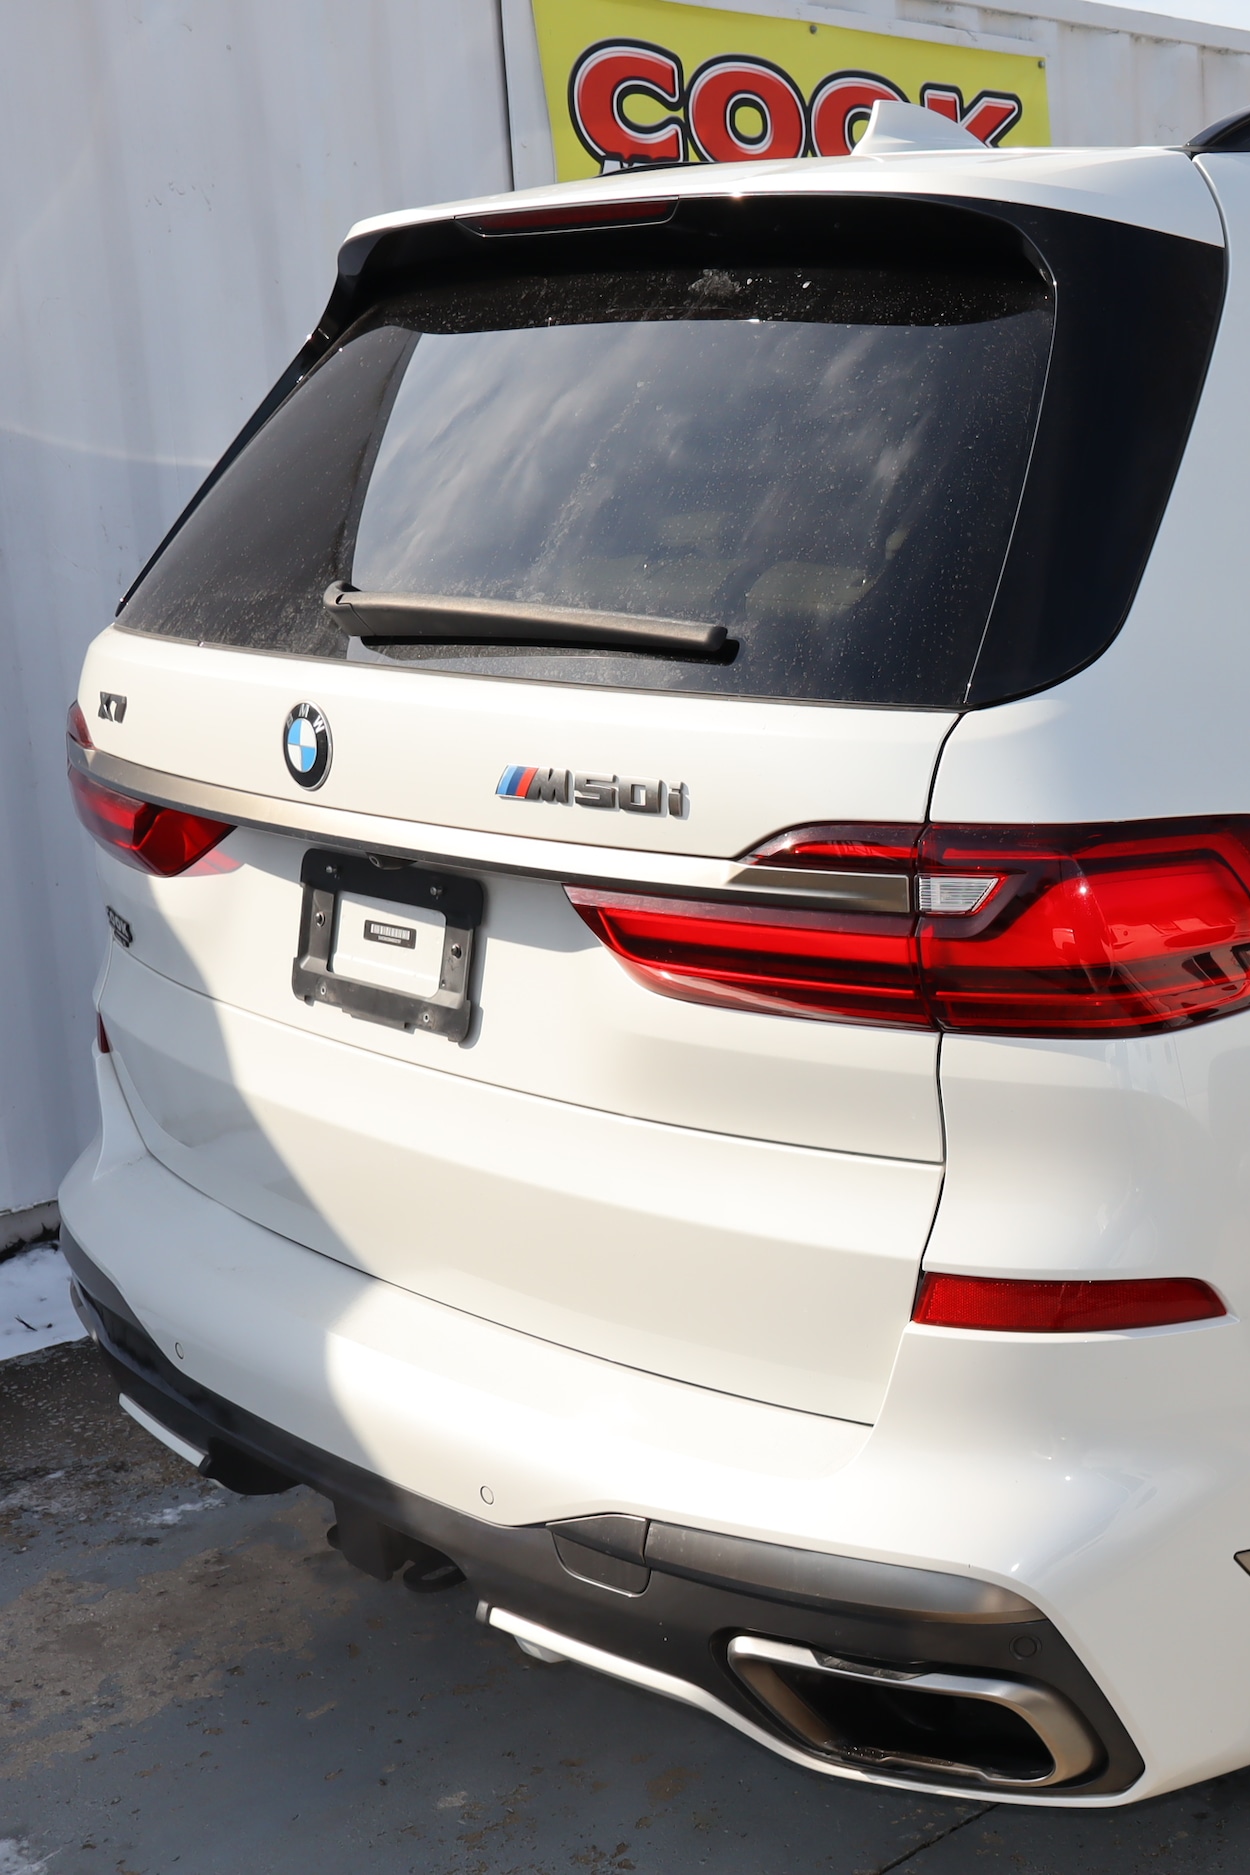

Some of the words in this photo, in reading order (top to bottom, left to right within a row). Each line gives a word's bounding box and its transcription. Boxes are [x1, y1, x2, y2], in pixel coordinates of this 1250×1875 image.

[98, 691, 127, 724] X7
[286, 704, 326, 734] BMW
[496, 764, 685, 816] M50i
